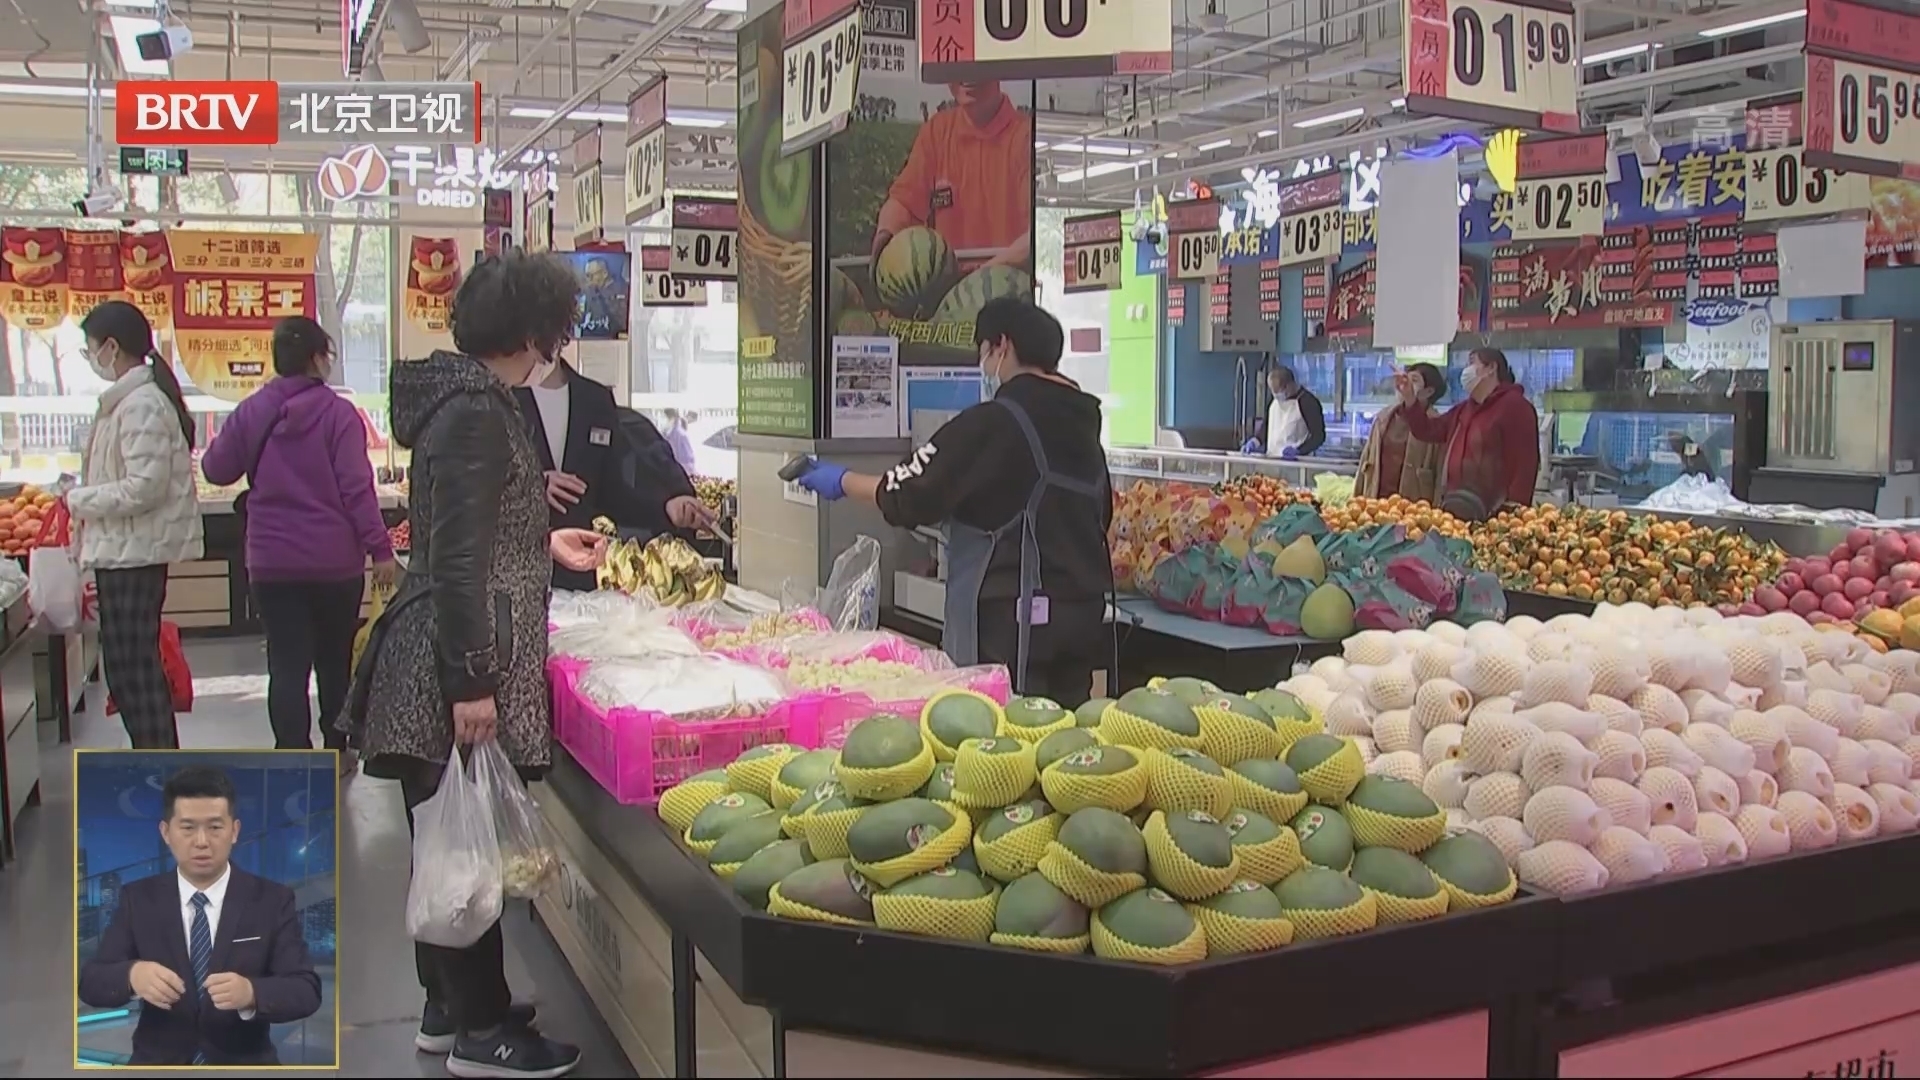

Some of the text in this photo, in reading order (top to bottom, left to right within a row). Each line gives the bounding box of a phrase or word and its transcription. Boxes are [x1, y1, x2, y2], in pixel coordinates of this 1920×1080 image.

[417, 188, 476, 208] DRIED
[202, 238, 281, 255] 十二道筛选
[184, 279, 304, 317] 板栗王
[1686, 301, 1750, 319] Seafood
